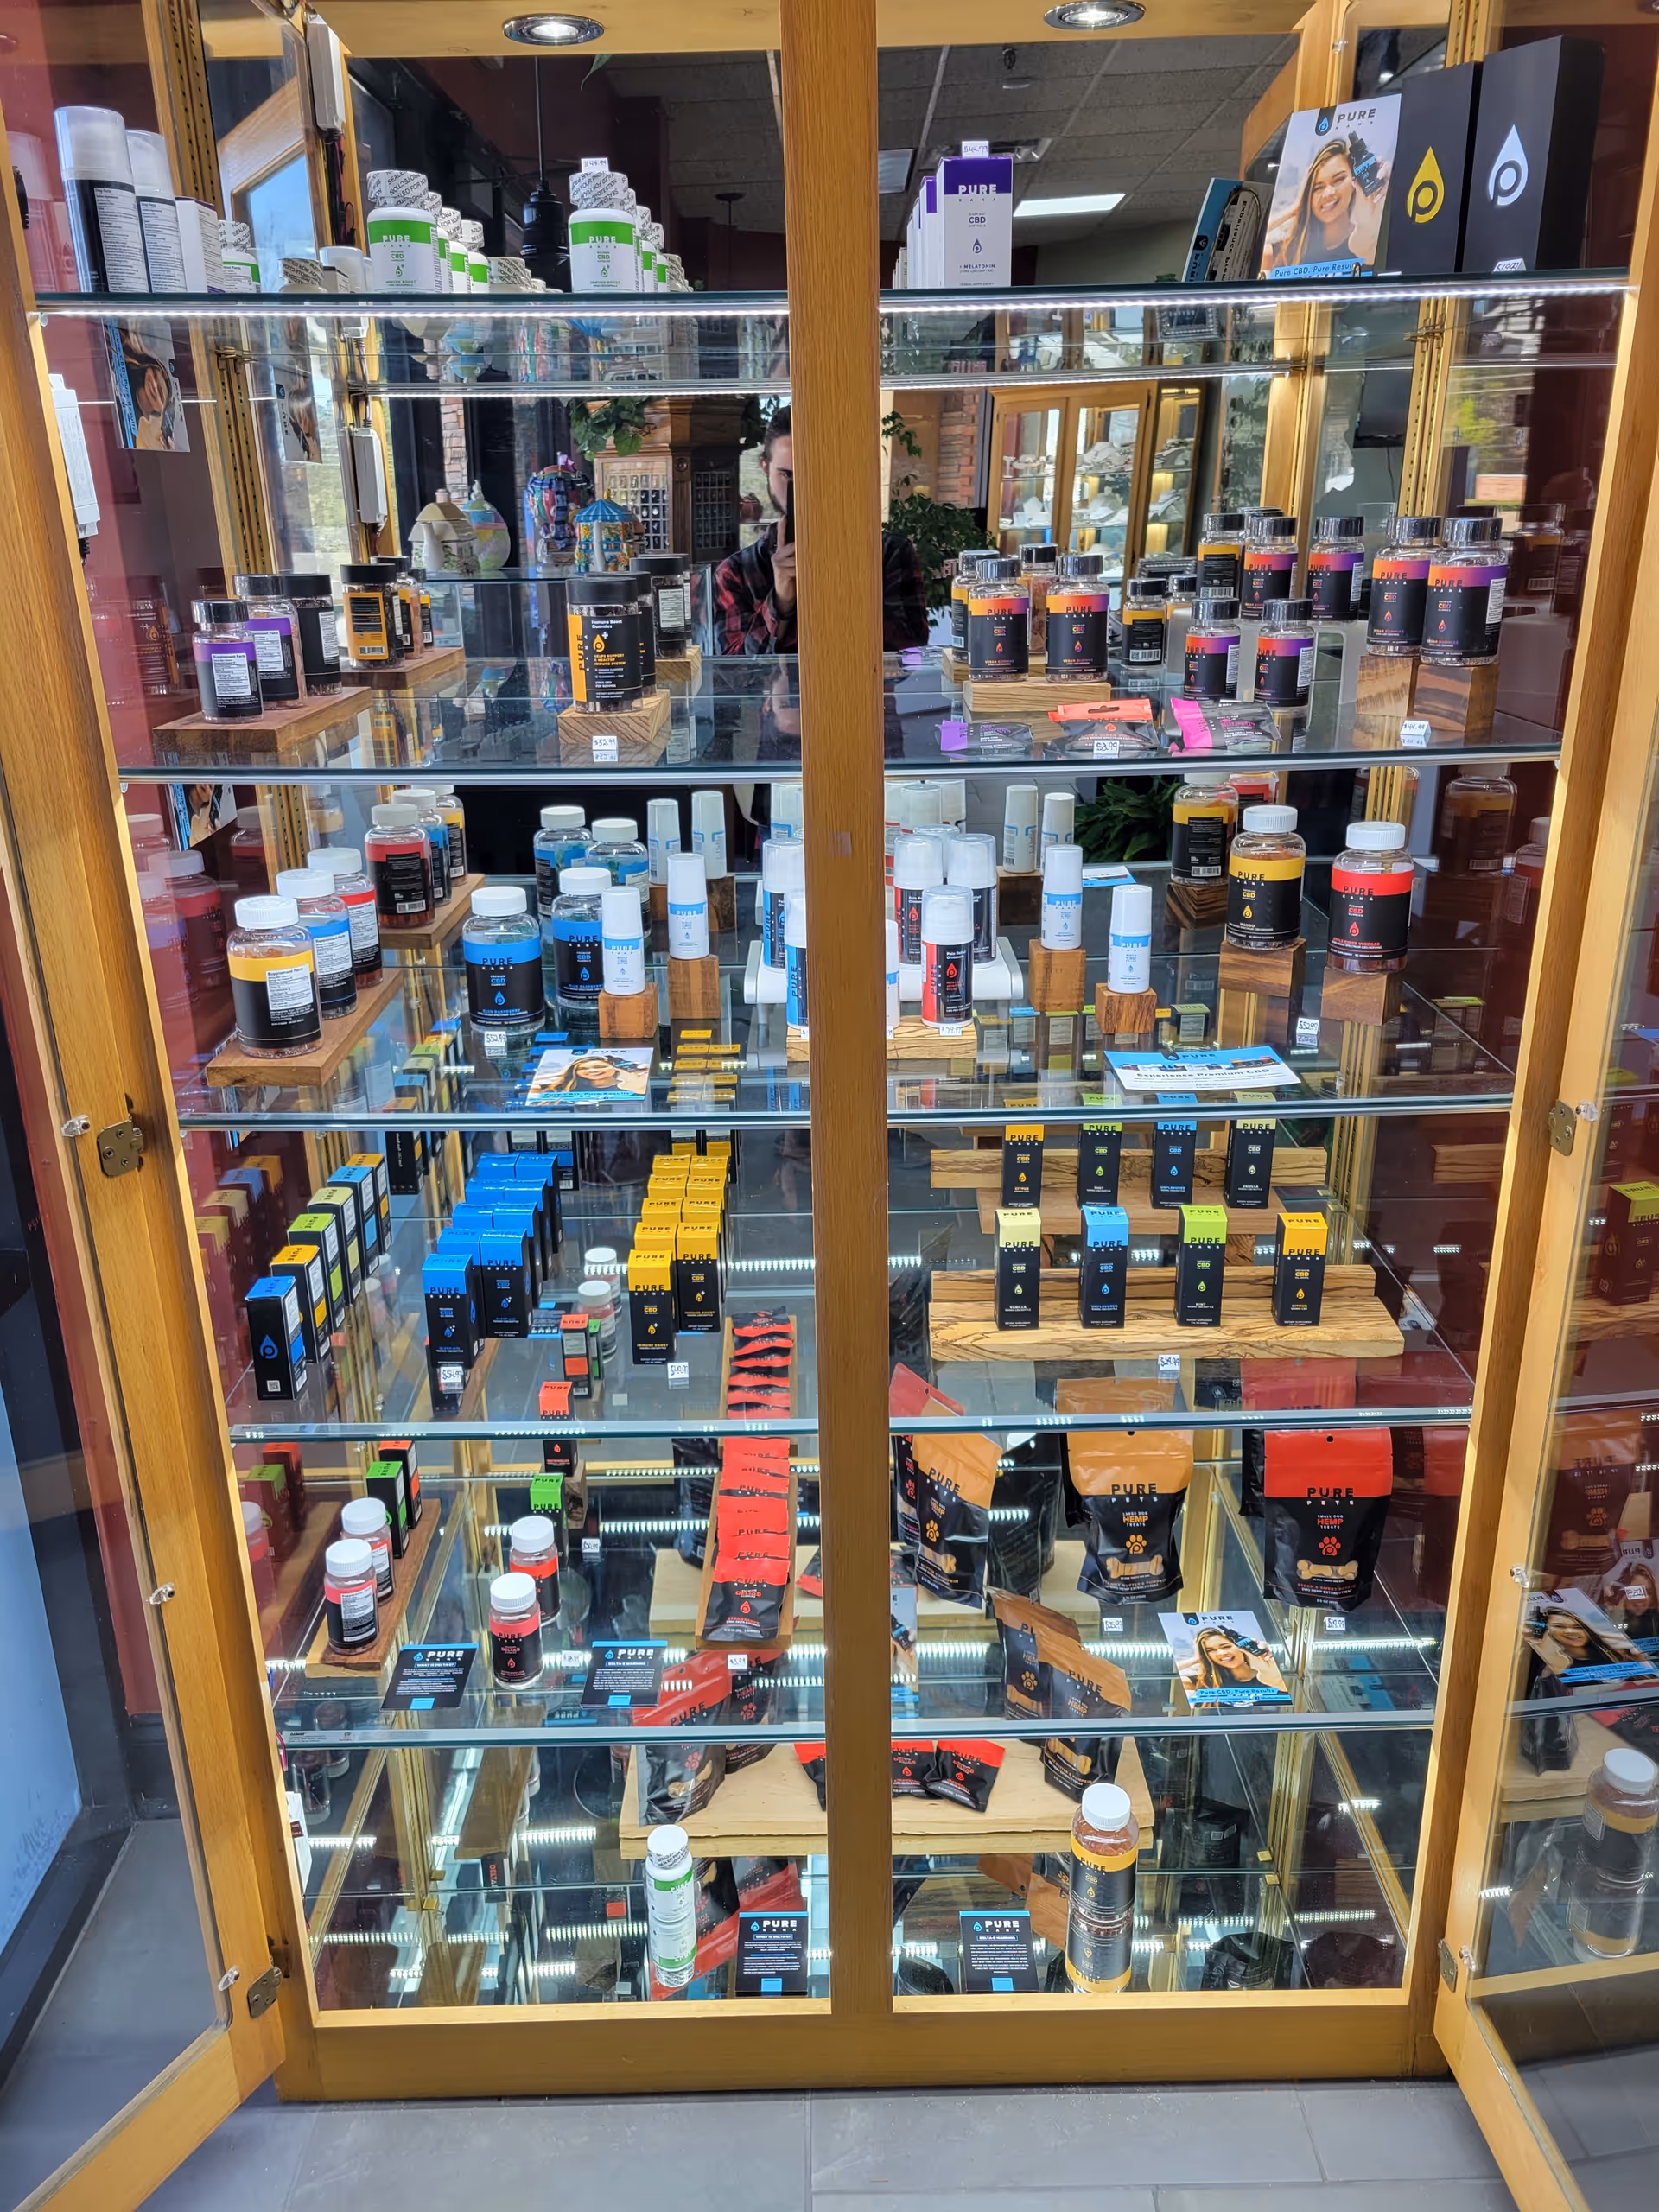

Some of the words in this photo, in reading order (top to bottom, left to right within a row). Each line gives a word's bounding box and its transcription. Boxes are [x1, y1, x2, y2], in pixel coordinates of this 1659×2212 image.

[1337, 108, 1376, 124] PURE
[958, 184, 997, 194] PURE
[589, 235, 616, 244] PURE
[1274, 269, 1291, 277] Pure
[1293, 266, 1311, 276] CBD.
[1332, 262, 1356, 271] Resul
[1096, 742, 1117, 752] $3.99
[1238, 872, 1265, 881] PURE
[1344, 886, 1374, 895] PURE
[482, 957, 512, 966] PURE
[929, 1467, 960, 1495] PURE
[739, 1484, 768, 1493] PURE
[1111, 1483, 1157, 1495] PURE
[1307, 1488, 1354, 1497] PURE
[931, 1500, 945, 1516] HEMP
[1068, 1669, 1103, 1695] PURE
[1068, 1700, 1088, 1713] HEMP
[671, 1701, 705, 1726] PURE
[1080, 1857, 1106, 1872] PURE
